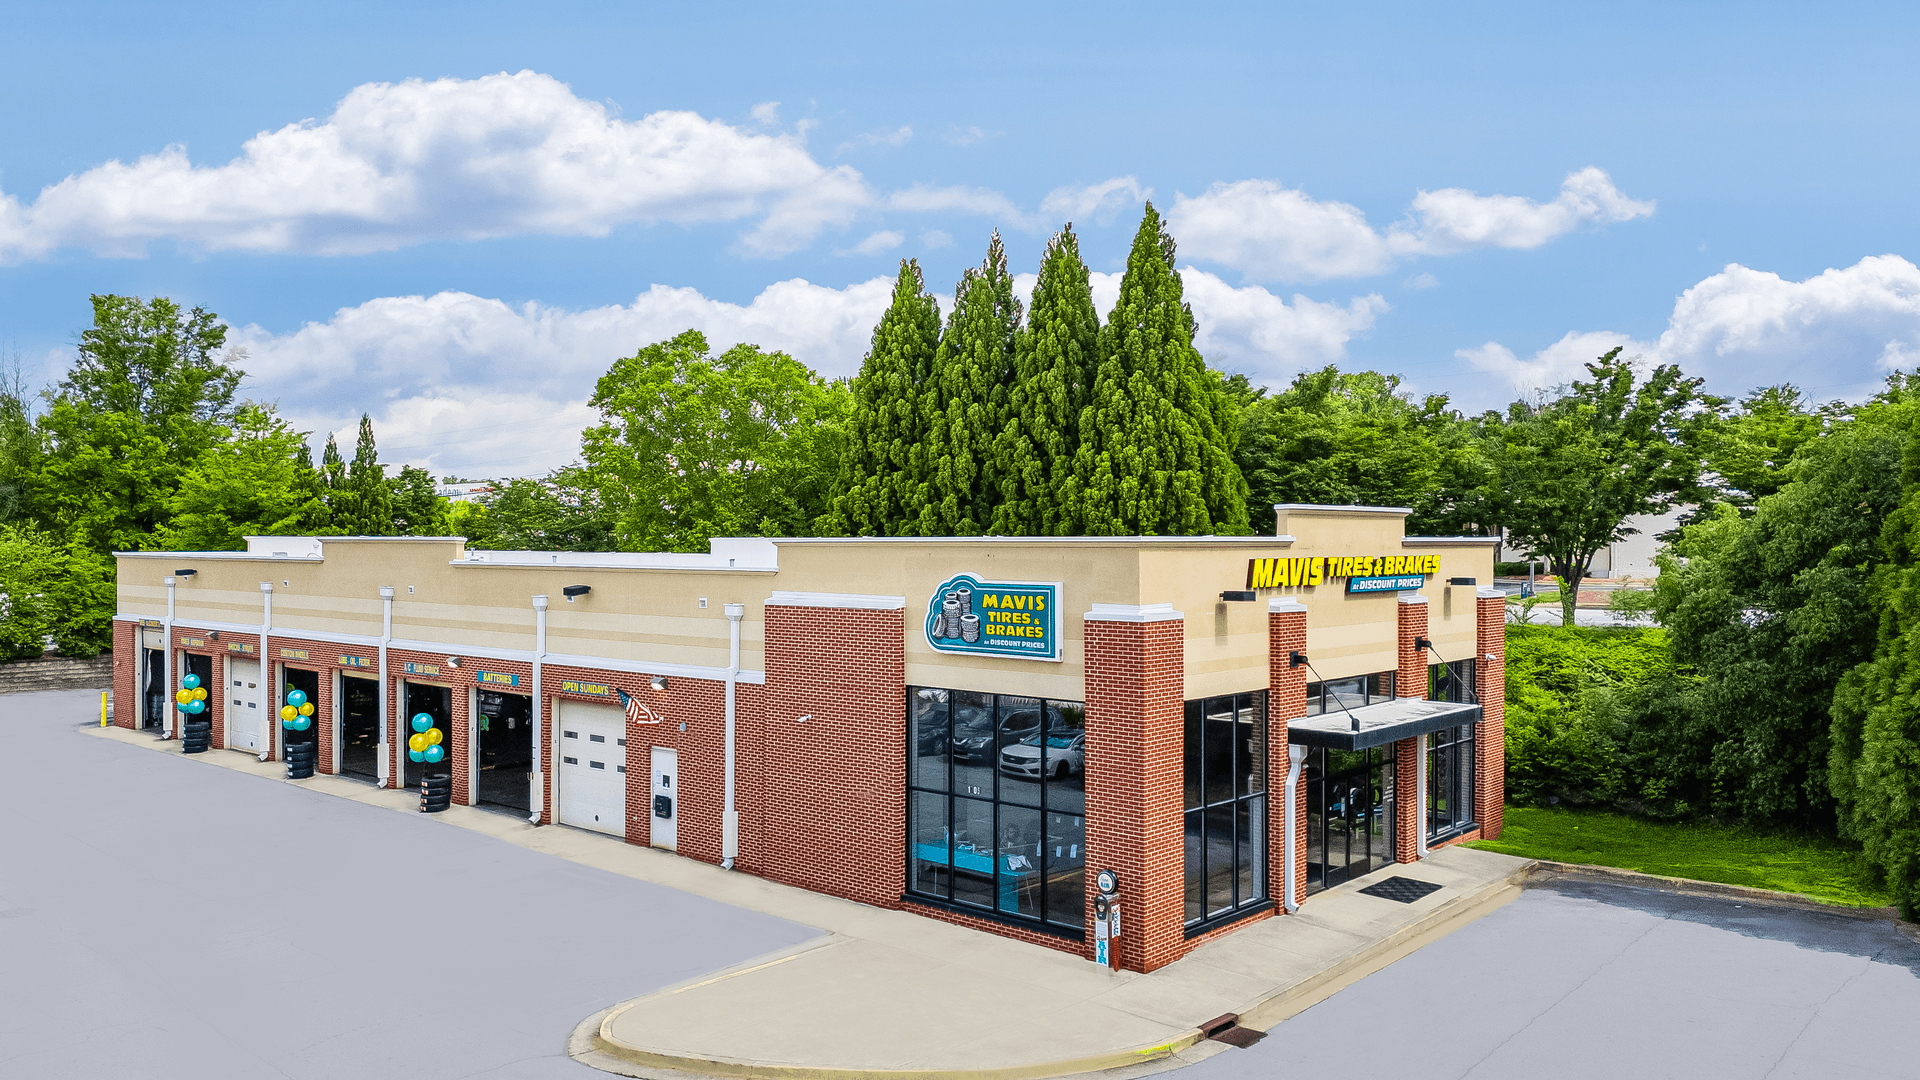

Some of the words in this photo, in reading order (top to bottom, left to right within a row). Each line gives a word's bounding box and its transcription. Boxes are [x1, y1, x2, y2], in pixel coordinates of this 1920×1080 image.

[1252, 557, 1324, 588] MAVIS
[1327, 556, 1374, 577] TIRES
[1373, 557, 1384, 575] &
[1384, 555, 1442, 575] BRAKES
[1359, 579, 1397, 590] DISCOUNT
[1397, 577, 1423, 588] PRICES
[982, 594, 1045, 611] MAVIS
[987, 611, 1031, 625] TIRES
[985, 624, 1044, 639] BRAKES
[990, 639, 1021, 647] DISCOUNT
[1021, 640, 1045, 648] PRICES
[483, 672, 513, 685] BATTERIES
[562, 681, 579, 692] OPEN
[580, 683, 609, 695] SUNDAYS
